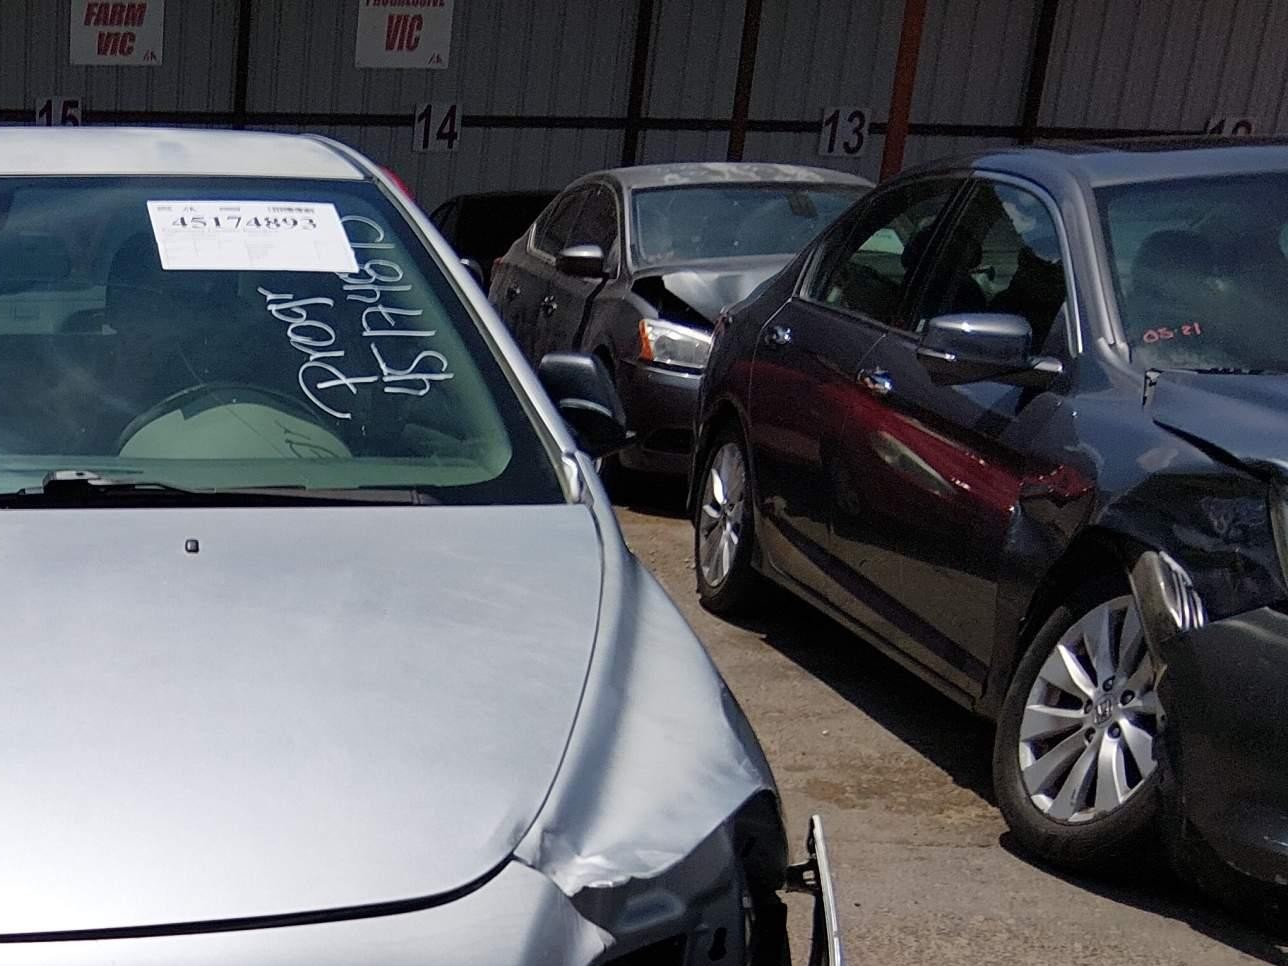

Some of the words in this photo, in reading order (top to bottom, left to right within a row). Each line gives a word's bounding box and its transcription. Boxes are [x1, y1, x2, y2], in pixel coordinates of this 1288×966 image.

[83, 2, 148, 26] FARM
[96, 31, 136, 56] VIC
[385, 13, 423, 52] VIC
[38, 99, 79, 126] 15
[417, 103, 458, 150] 14
[823, 109, 866, 154] 13
[172, 216, 317, 230] 45174893
